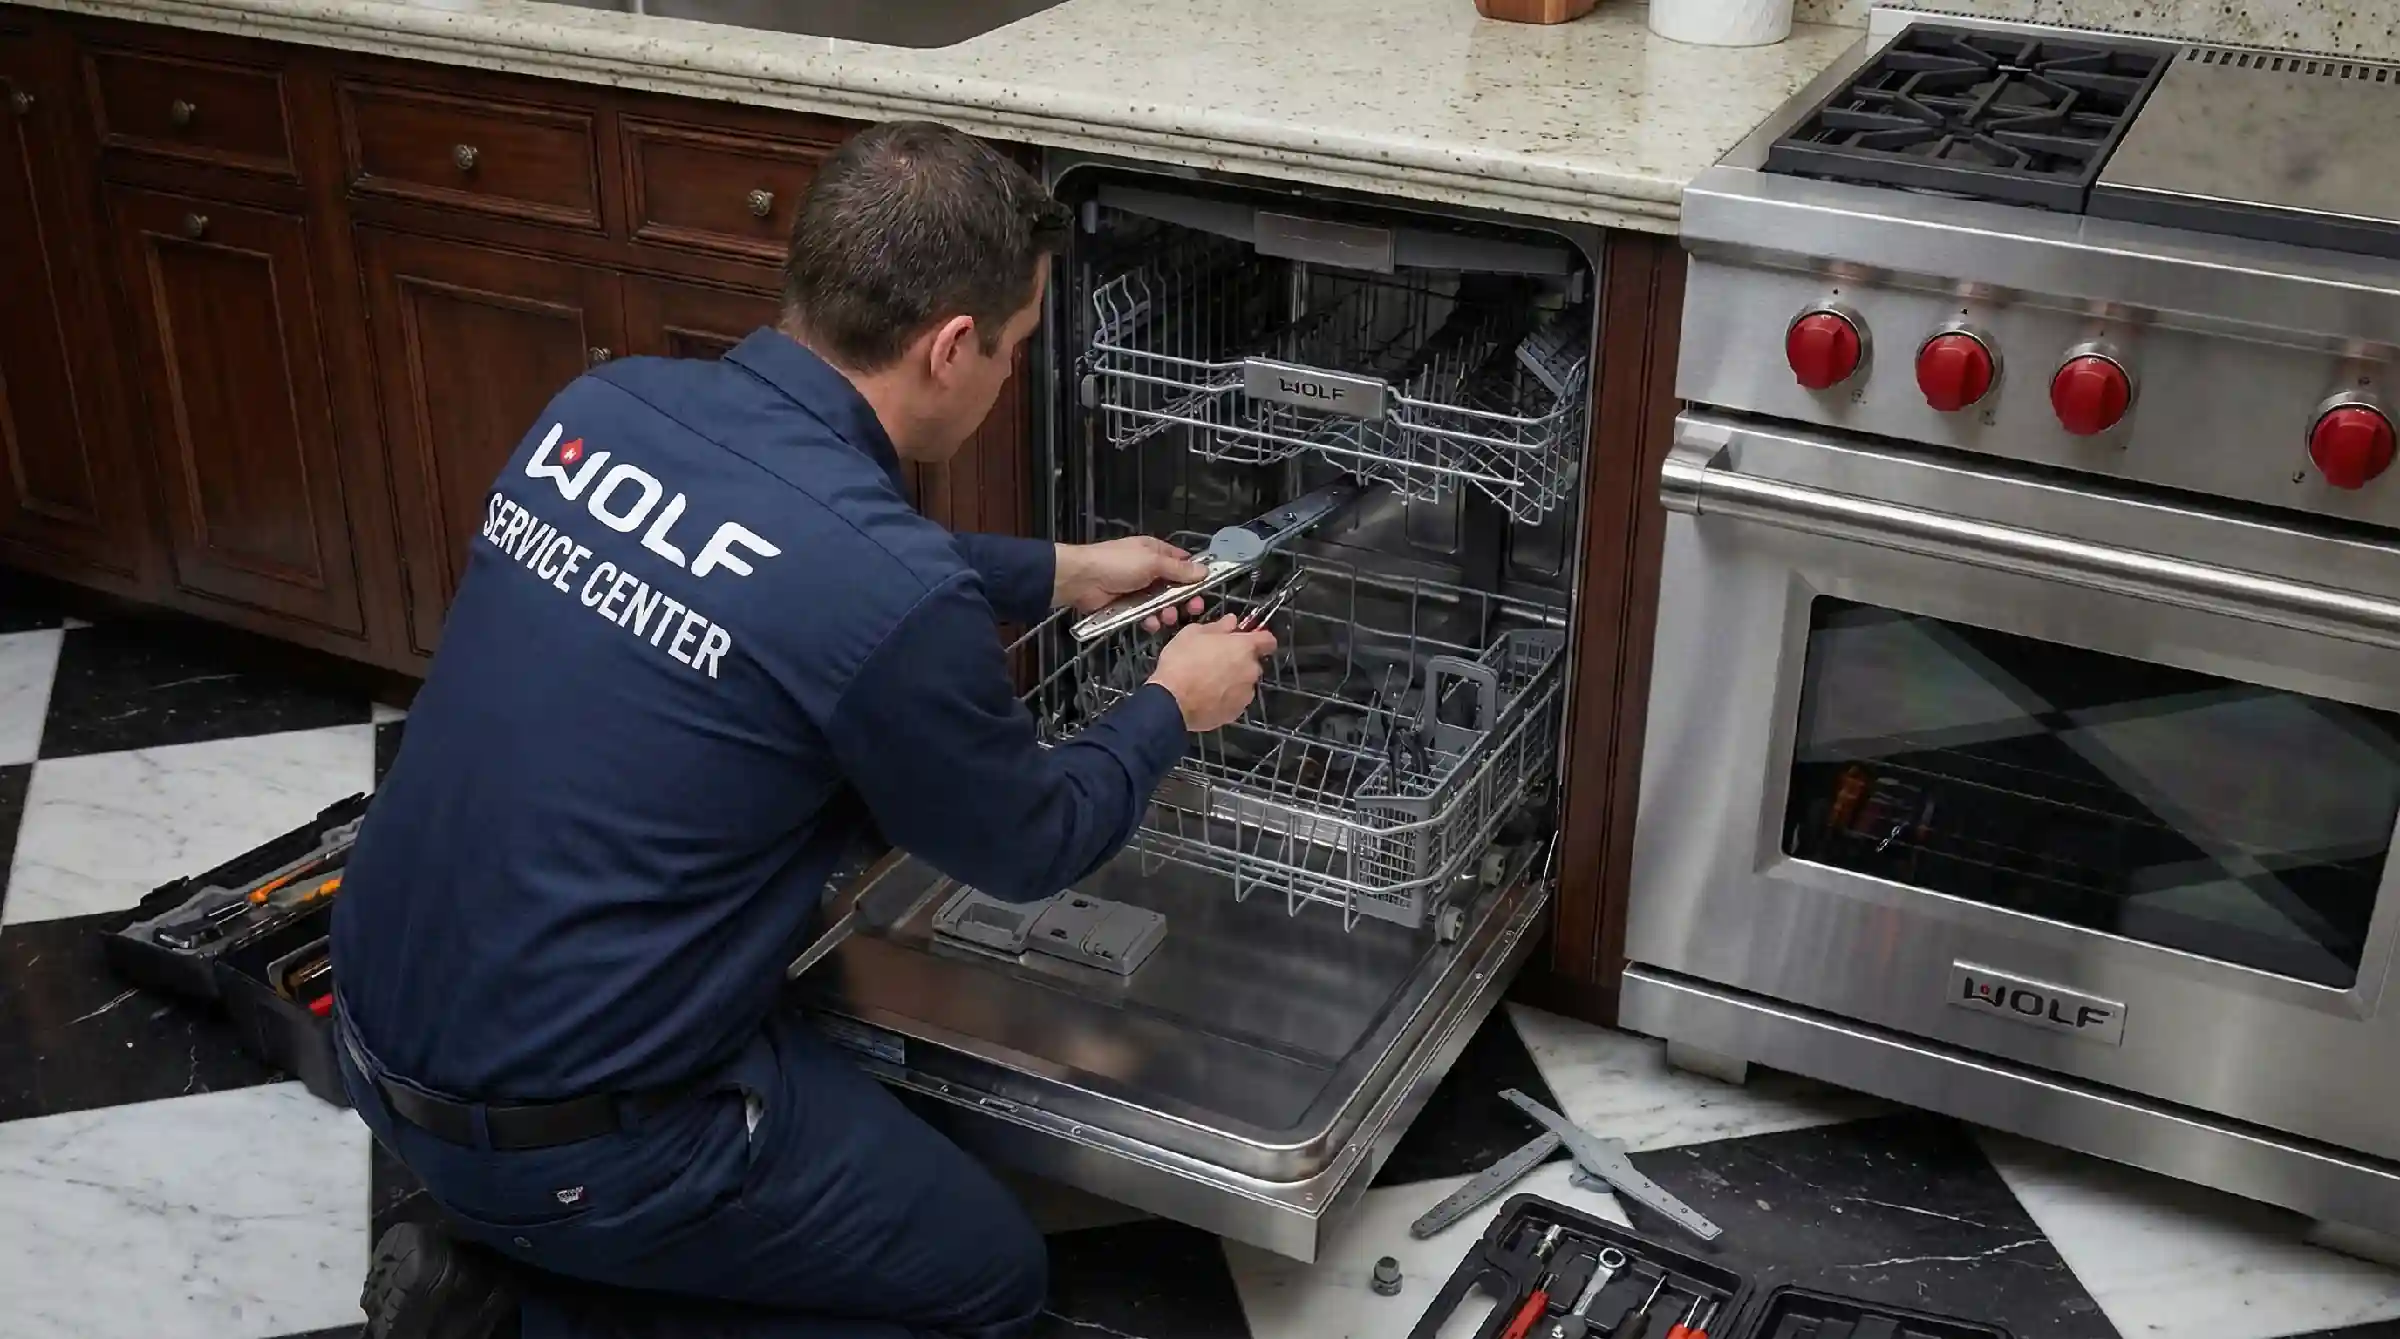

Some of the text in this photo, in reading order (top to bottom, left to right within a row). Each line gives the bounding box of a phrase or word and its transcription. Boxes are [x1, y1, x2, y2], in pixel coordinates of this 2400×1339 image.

[1278, 377, 1345, 400] WOLF
[525, 422, 782, 578] WOLF
[483, 492, 732, 679] SERVICE CENTER
[1963, 976, 2111, 1028] WOLF
